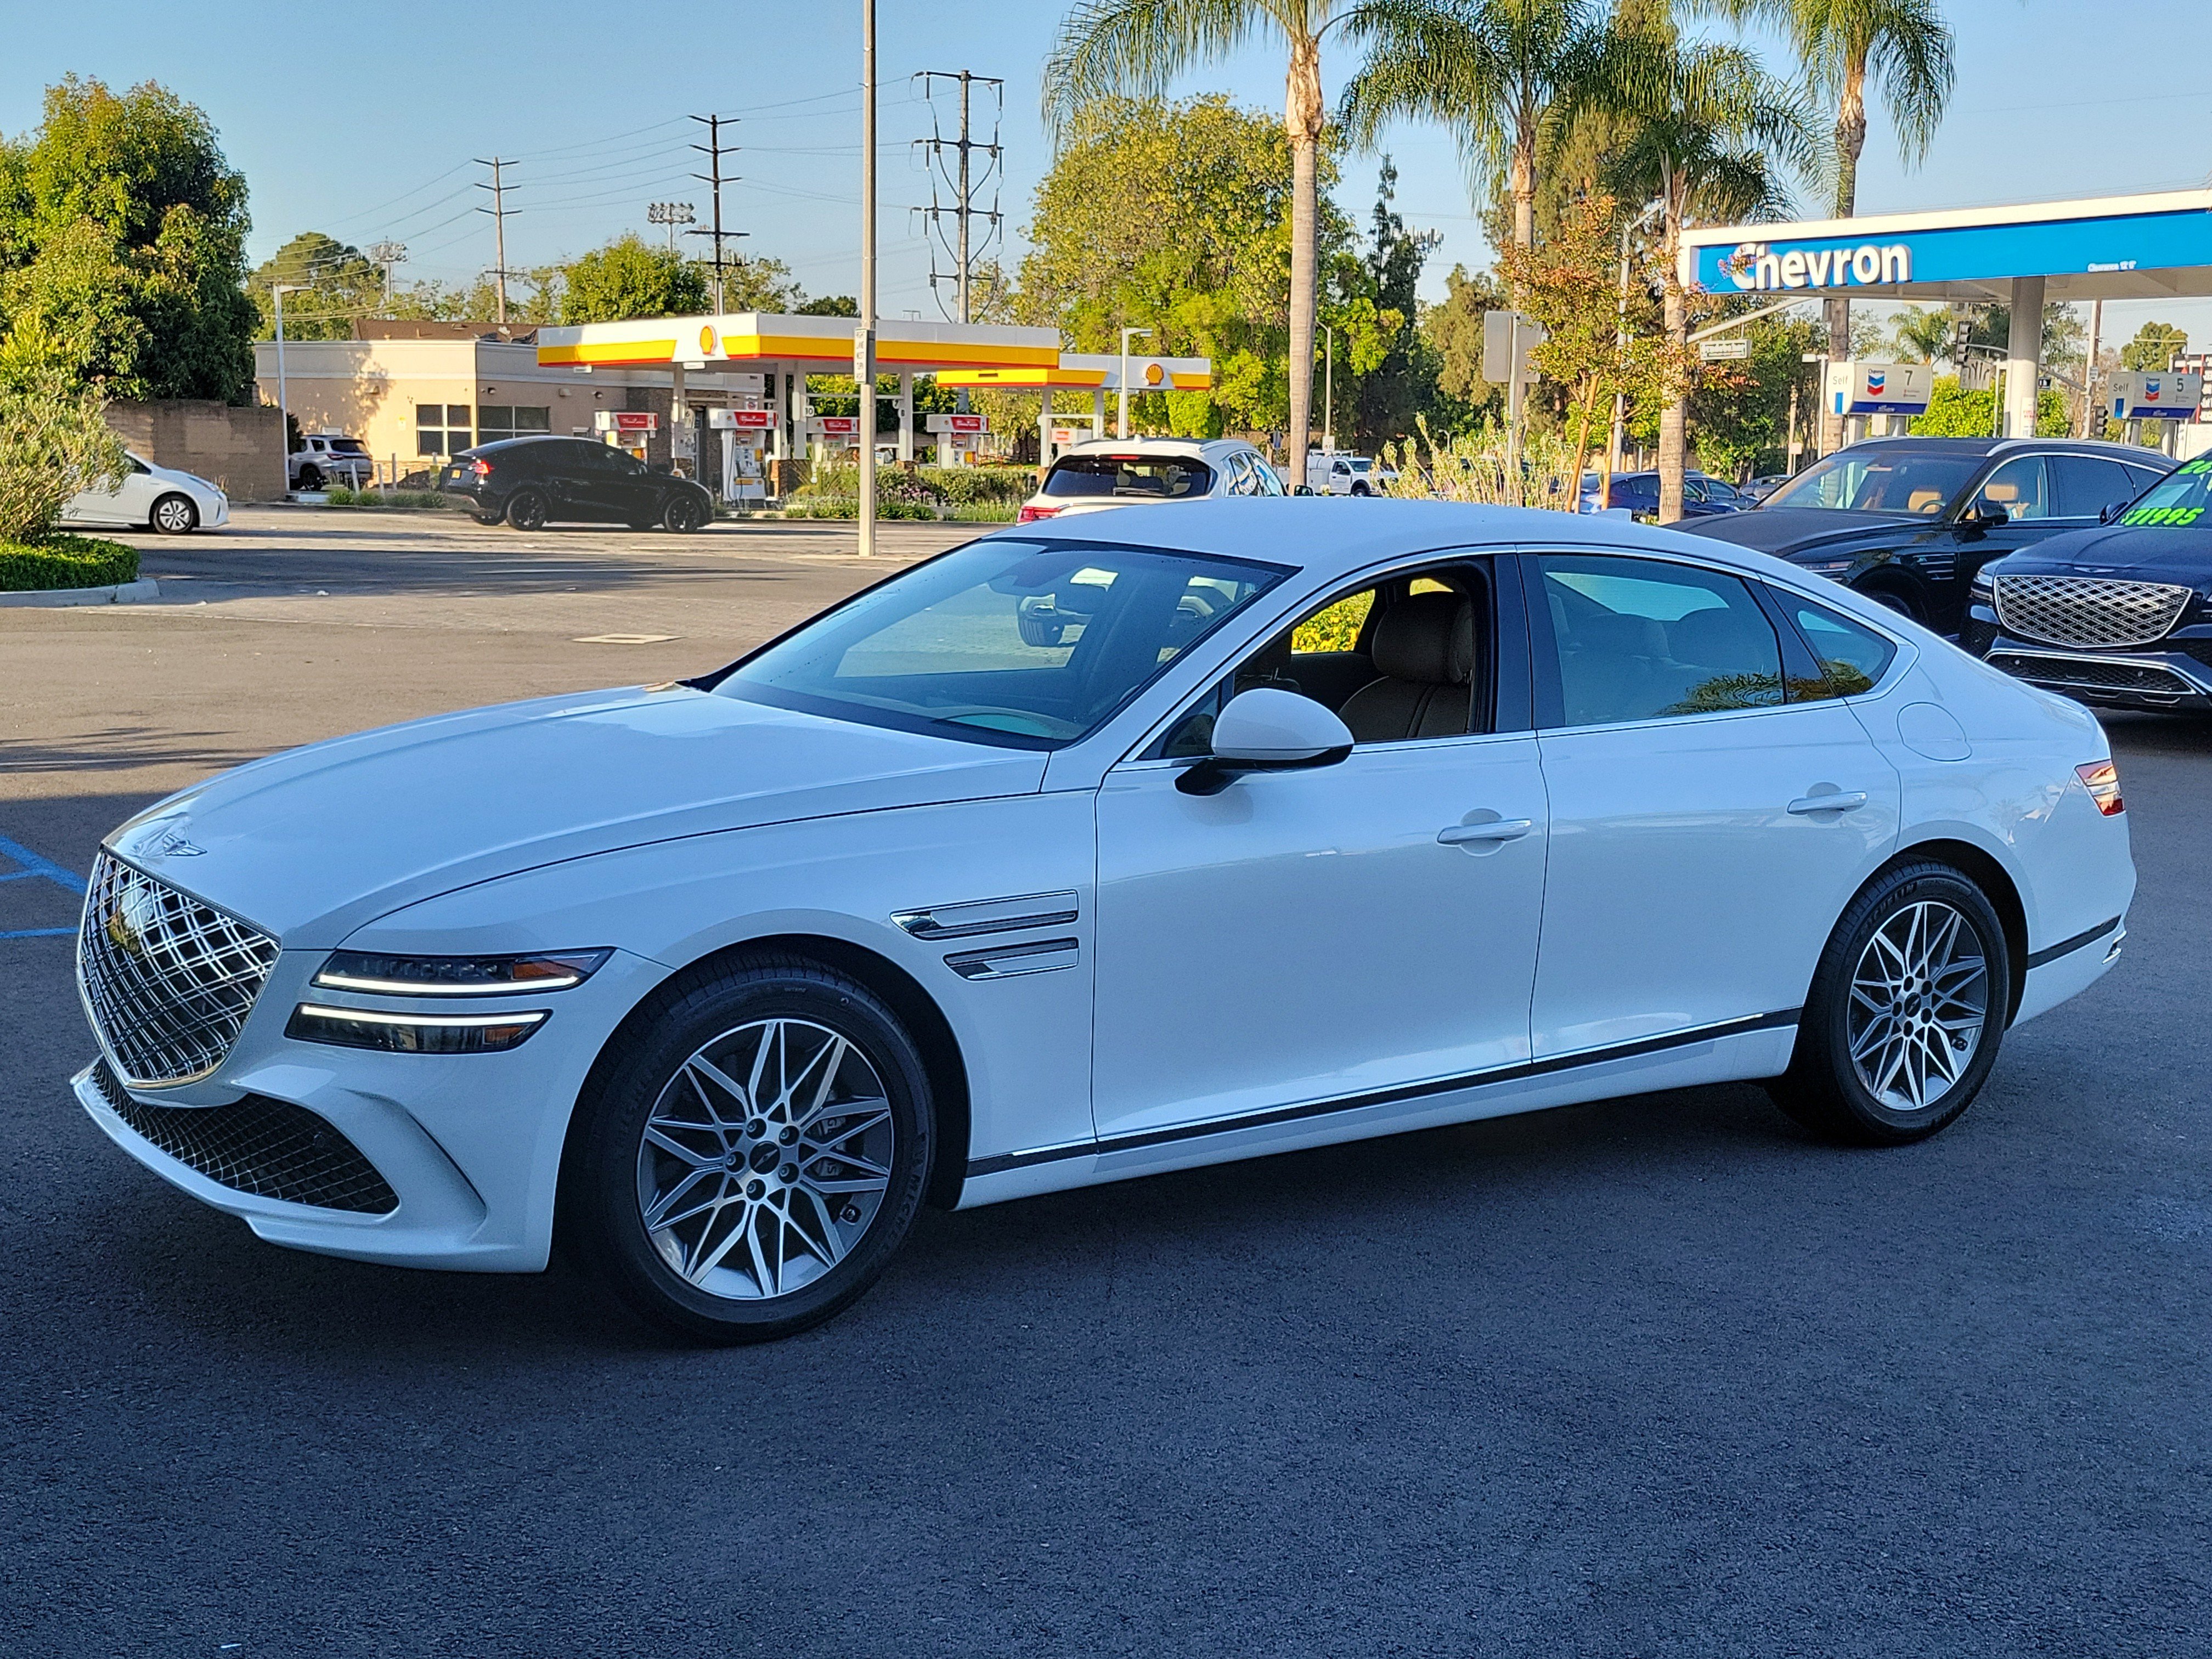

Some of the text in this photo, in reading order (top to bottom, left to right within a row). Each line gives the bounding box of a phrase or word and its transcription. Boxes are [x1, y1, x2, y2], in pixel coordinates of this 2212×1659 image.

[1731, 242, 1910, 290] Chevron
[1832, 375, 1848, 385] Self
[1904, 370, 1913, 386] 7
[2176, 377, 2184, 392] 5
[2113, 383, 2129, 392] Self
